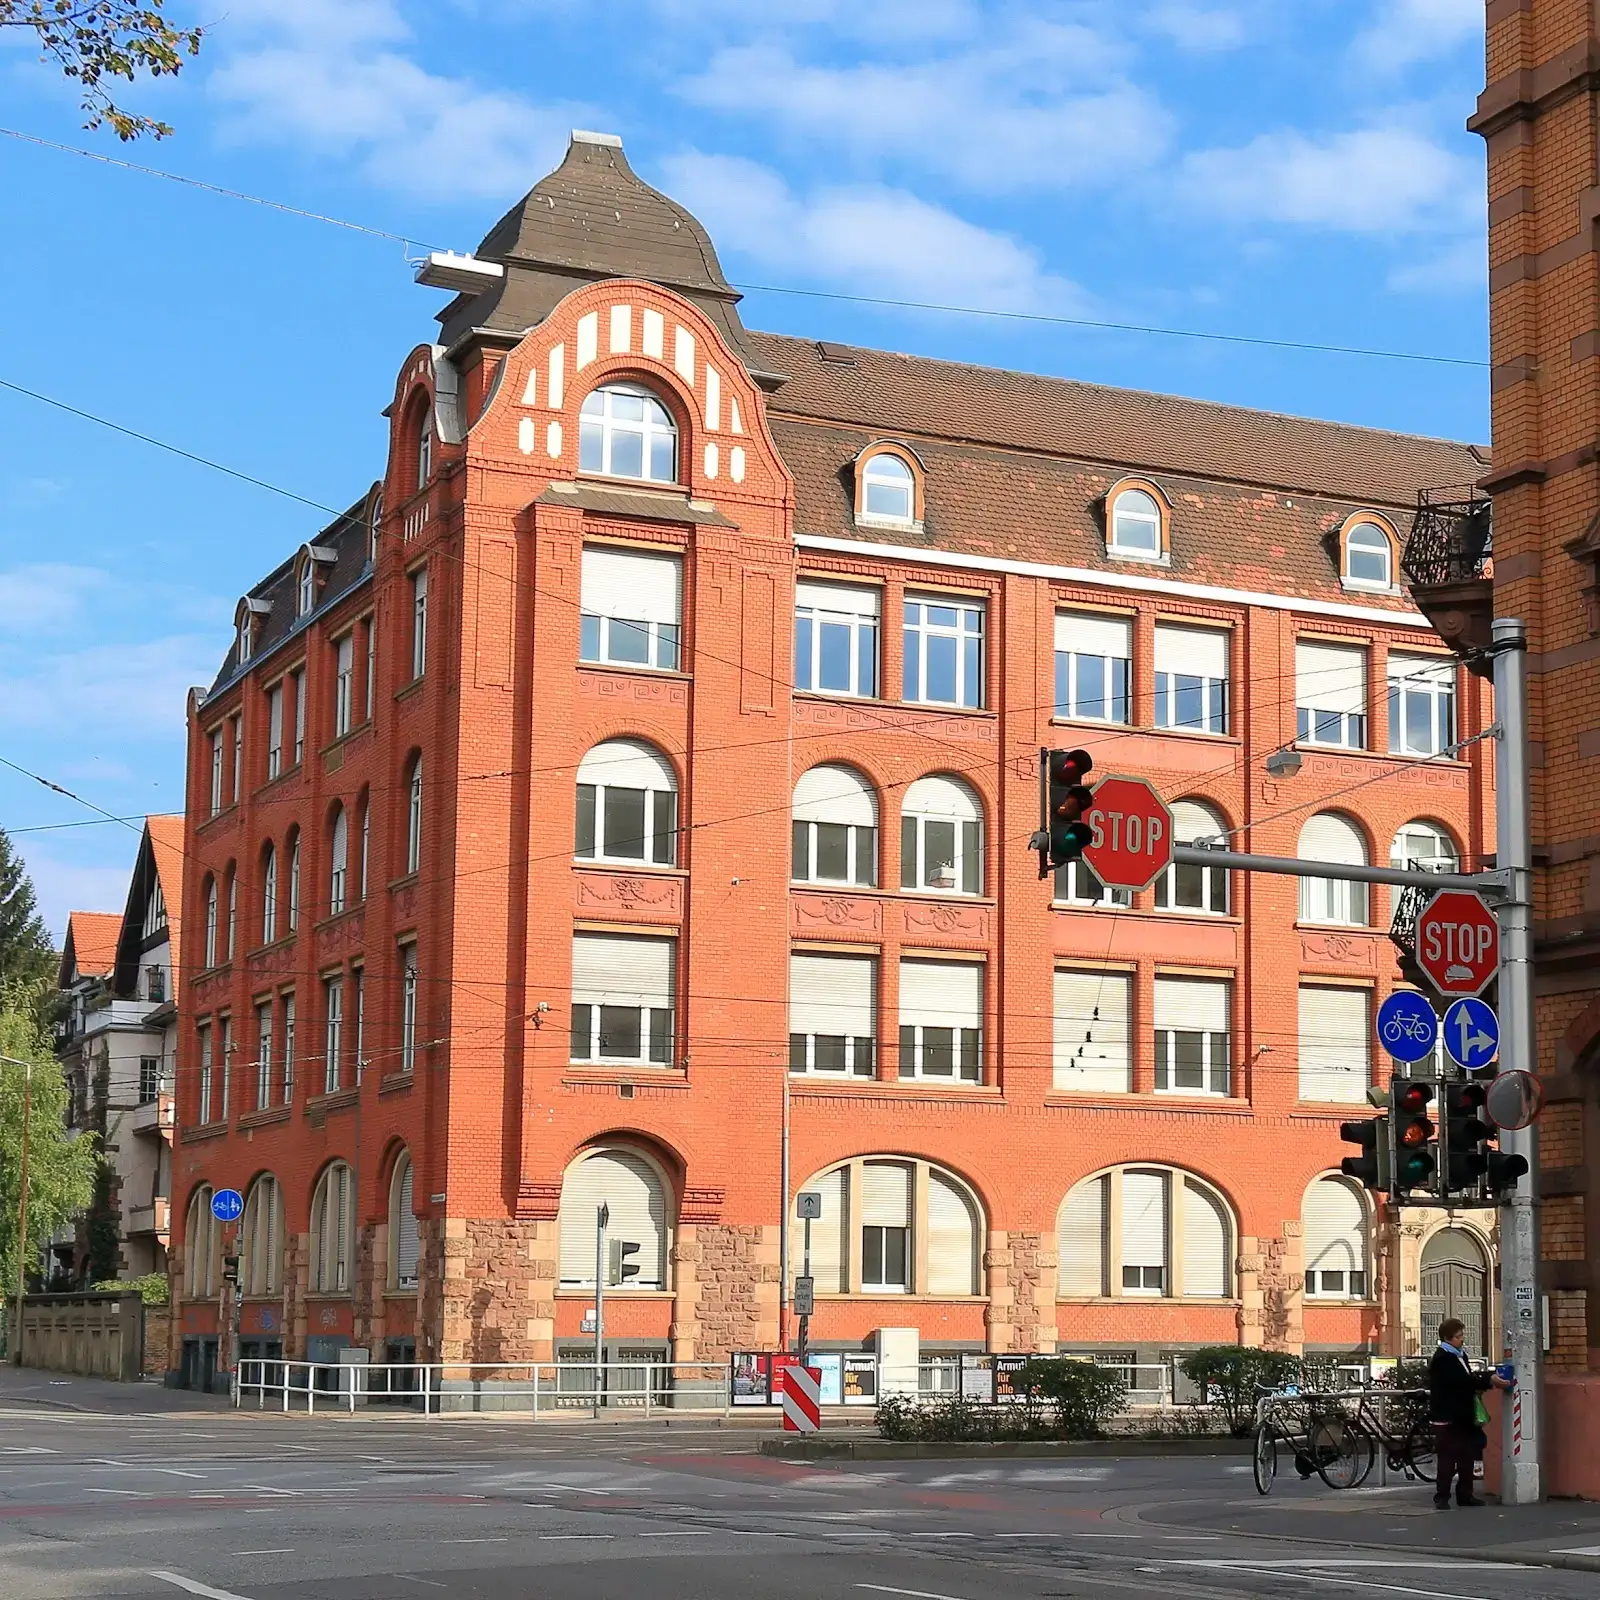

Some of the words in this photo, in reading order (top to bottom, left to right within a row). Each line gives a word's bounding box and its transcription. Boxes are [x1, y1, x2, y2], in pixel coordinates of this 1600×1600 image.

[1089, 809, 1163, 856] STOP
[1425, 920, 1493, 964] STOP
[844, 1360, 875, 1371] Armut
[845, 1372, 859, 1383] für
[997, 1372, 1011, 1383] für
[844, 1384, 863, 1395] alle
[997, 1384, 1014, 1394] alle
